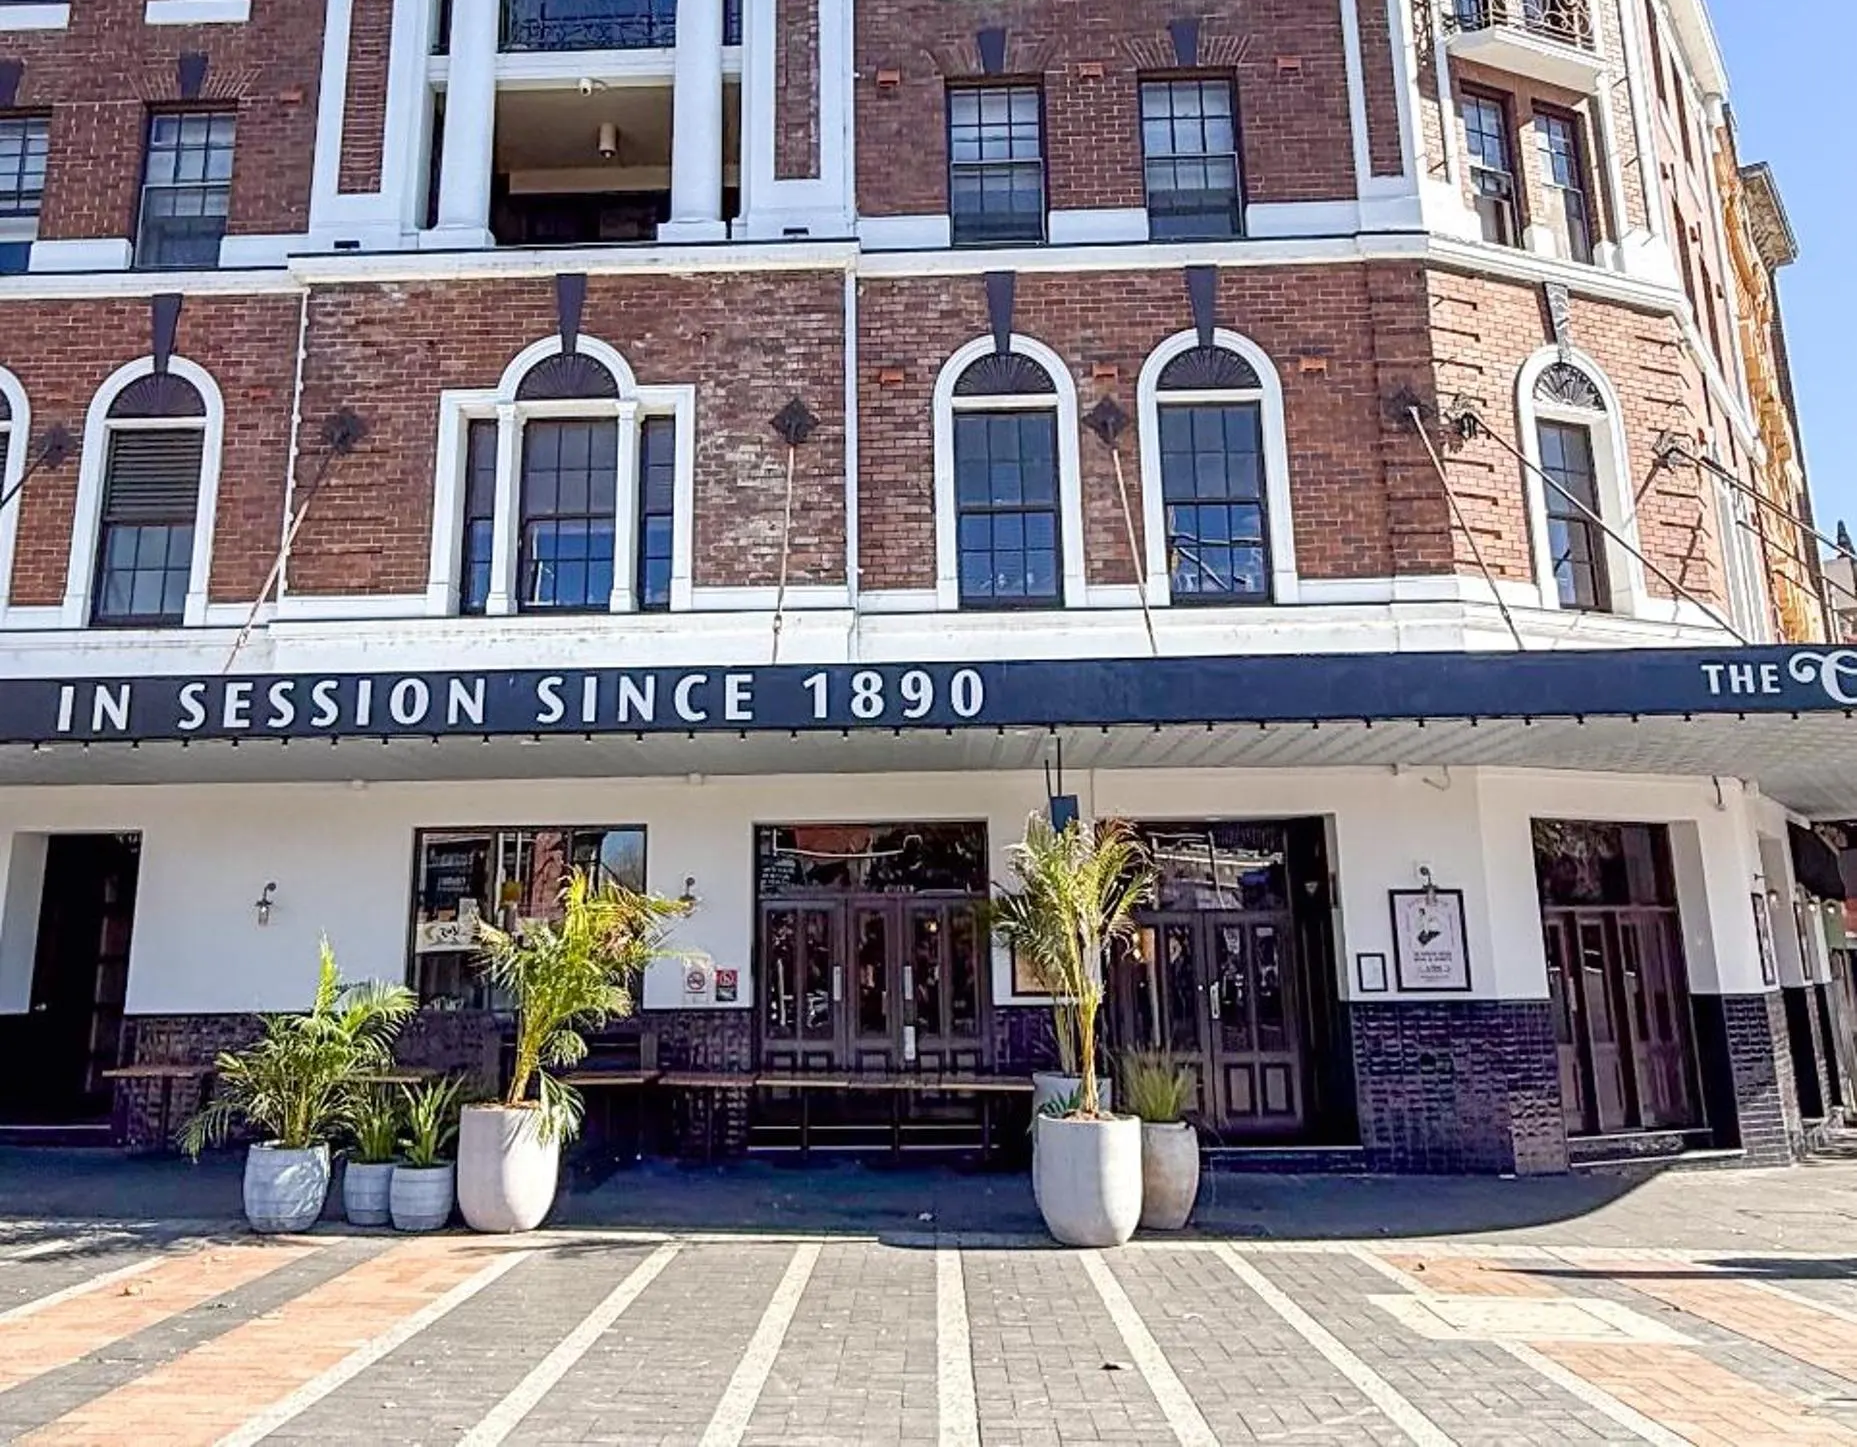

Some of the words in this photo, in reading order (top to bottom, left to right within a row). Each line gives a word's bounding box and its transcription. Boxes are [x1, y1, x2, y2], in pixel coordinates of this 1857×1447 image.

[57, 684, 131, 732] IN
[178, 678, 486, 730] SESSION
[536, 674, 753, 724] SINCE
[803, 669, 984, 720] 1890
[1701, 664, 1781, 694] THE
